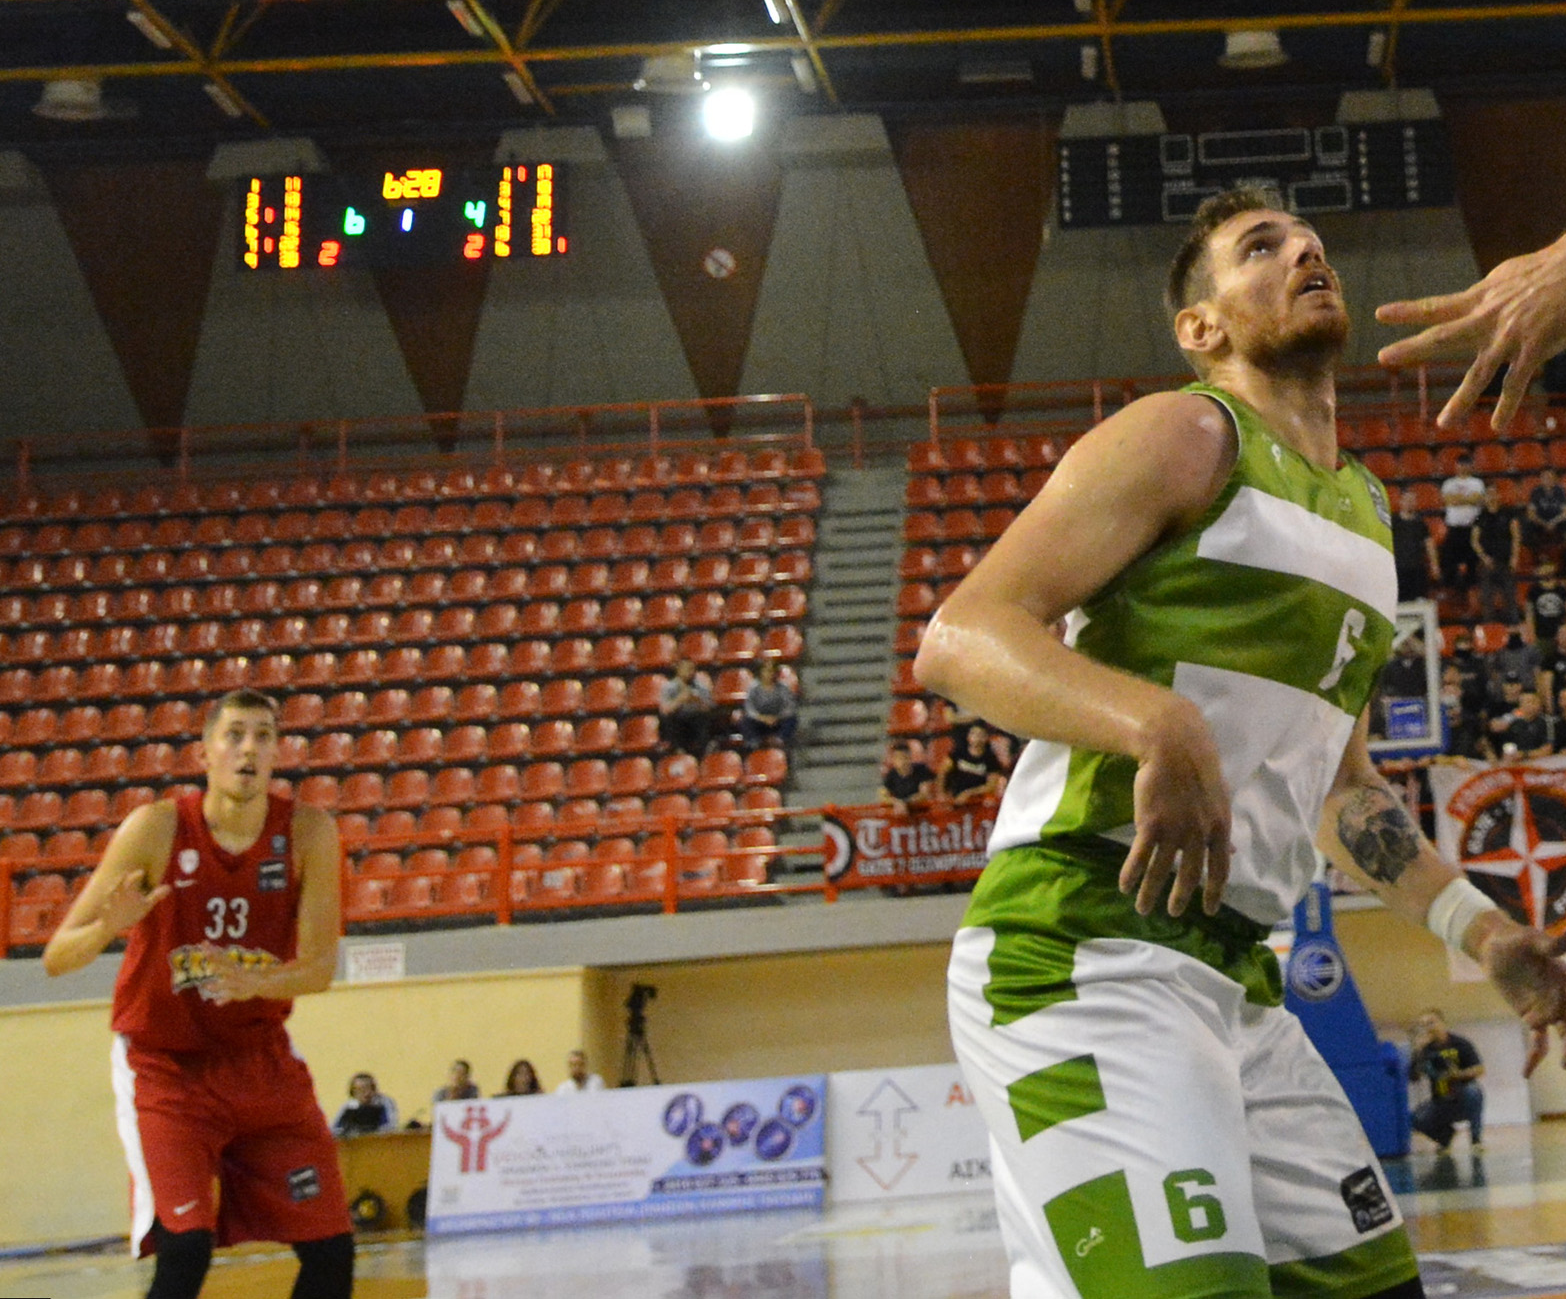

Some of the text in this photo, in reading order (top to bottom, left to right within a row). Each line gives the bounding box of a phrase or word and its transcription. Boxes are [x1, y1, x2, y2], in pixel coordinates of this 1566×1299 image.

[343, 206, 366, 236] 6
[464, 200, 486, 228] 4
[318, 233, 485, 266] 2 2
[204, 896, 250, 940] 33
[1162, 1167, 1229, 1244] 6
